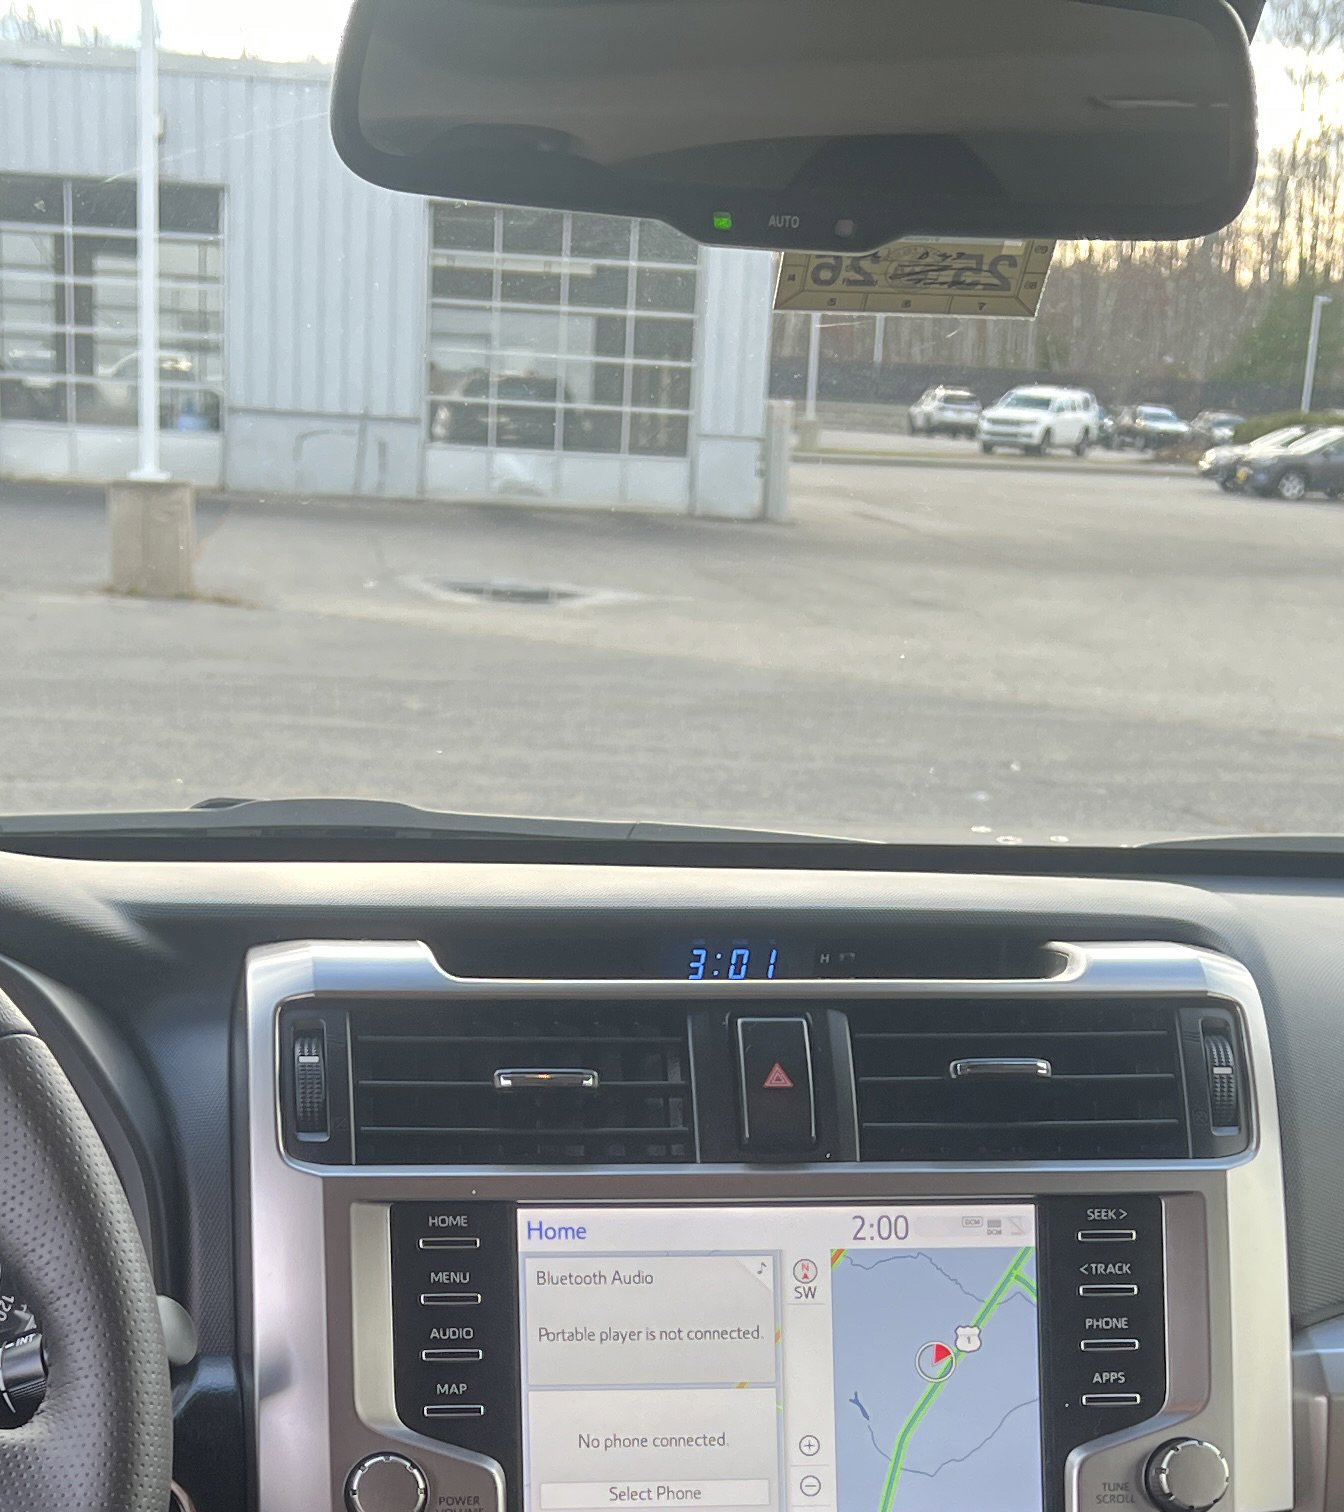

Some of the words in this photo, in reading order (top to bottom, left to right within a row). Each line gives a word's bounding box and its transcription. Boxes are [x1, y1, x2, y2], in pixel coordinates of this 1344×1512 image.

[768, 214, 800, 229] AUTO
[687, 947, 779, 980] 3:01
[1086, 1208, 1117, 1221] SEEK
[428, 1215, 468, 1228] HOME
[851, 1215, 910, 1241] 2:00
[527, 1219, 587, 1240] Home
[801, 1262, 810, 1271] N
[1090, 1263, 1131, 1275] TRACK
[430, 1271, 470, 1284] MENU
[536, 1270, 606, 1286] Bluetooth
[611, 1270, 654, 1286] Audio
[793, 1285, 817, 1300] SW
[1085, 1317, 1129, 1330] PHONE
[15, 1333, 37, 1347] INT
[430, 1327, 474, 1340] AUDIO
[538, 1326, 596, 1343] Portable
[599, 1327, 643, 1345] player
[645, 1327, 656, 1342] is
[659, 1327, 683, 1342] not
[686, 1325, 764, 1341] connected.
[1092, 1371, 1126, 1385] APPS
[436, 1383, 468, 1396] MAP
[578, 1433, 601, 1449] No
[604, 1434, 648, 1451] phone
[652, 1433, 730, 1448] connected.
[608, 1486, 652, 1501] Select
[656, 1485, 702, 1501] Phone
[1101, 1481, 1130, 1493] TUNE
[438, 1495, 481, 1507] POWER
[1095, 1493, 1135, 1505] SCROLL
